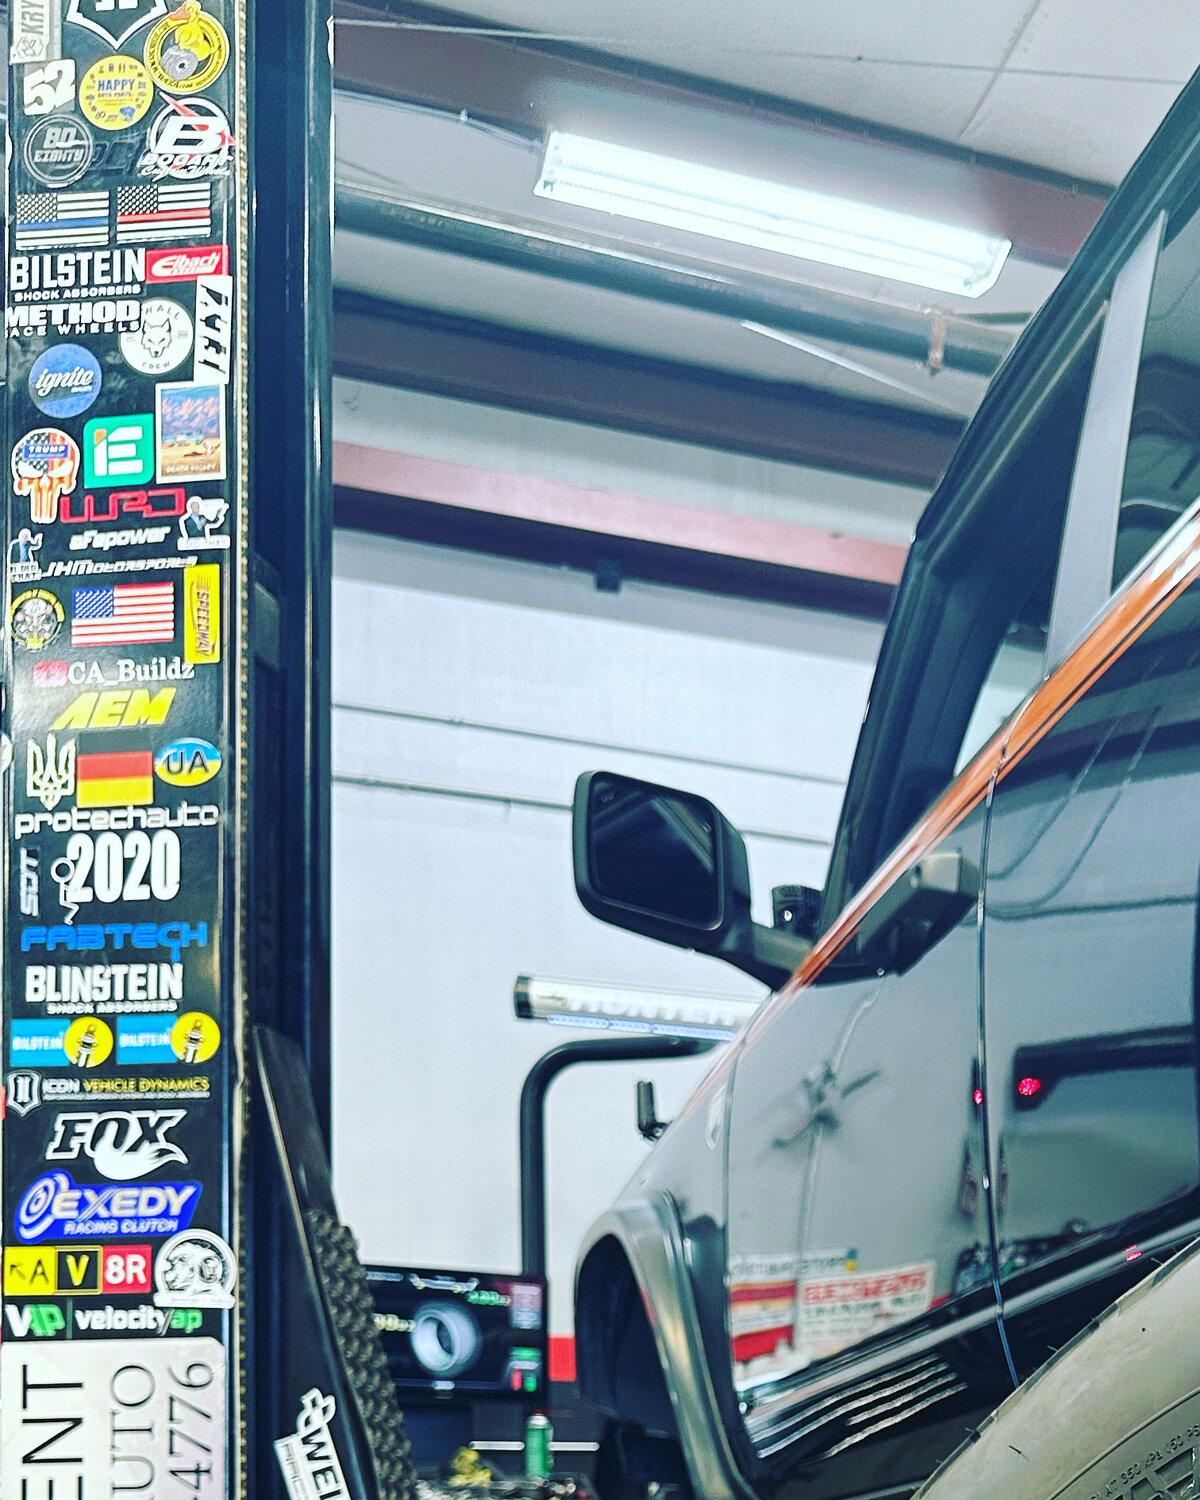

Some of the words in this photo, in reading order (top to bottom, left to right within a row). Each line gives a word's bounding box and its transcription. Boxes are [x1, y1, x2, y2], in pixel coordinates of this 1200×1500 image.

[97, 79, 135, 91] HAPPY
[10, 248, 146, 291] BILSTEIN
[14, 290, 60, 302] SHOCK
[63, 284, 142, 299] ABSORBERS
[5, 300, 141, 327] METHOD
[57, 320, 140, 335] WHEELS
[67, 657, 195, 687] CA_Buildz
[50, 687, 177, 730] AEM
[166, 750, 210, 775] UA
[66, 829, 181, 903] 2020
[21, 921, 208, 955] FABTECH
[47, 1003, 94, 1014] SHOCK
[96, 1000, 178, 1013] ABSORBERS
[83, 1078, 136, 1093] VEHICLE
[139, 1076, 210, 1092] DYNAMICS
[46, 1109, 188, 1162] FOX
[52, 1186, 197, 1219] EXEDY
[64, 1220, 118, 1235] RACING
[121, 1218, 179, 1233] CLUTCH
